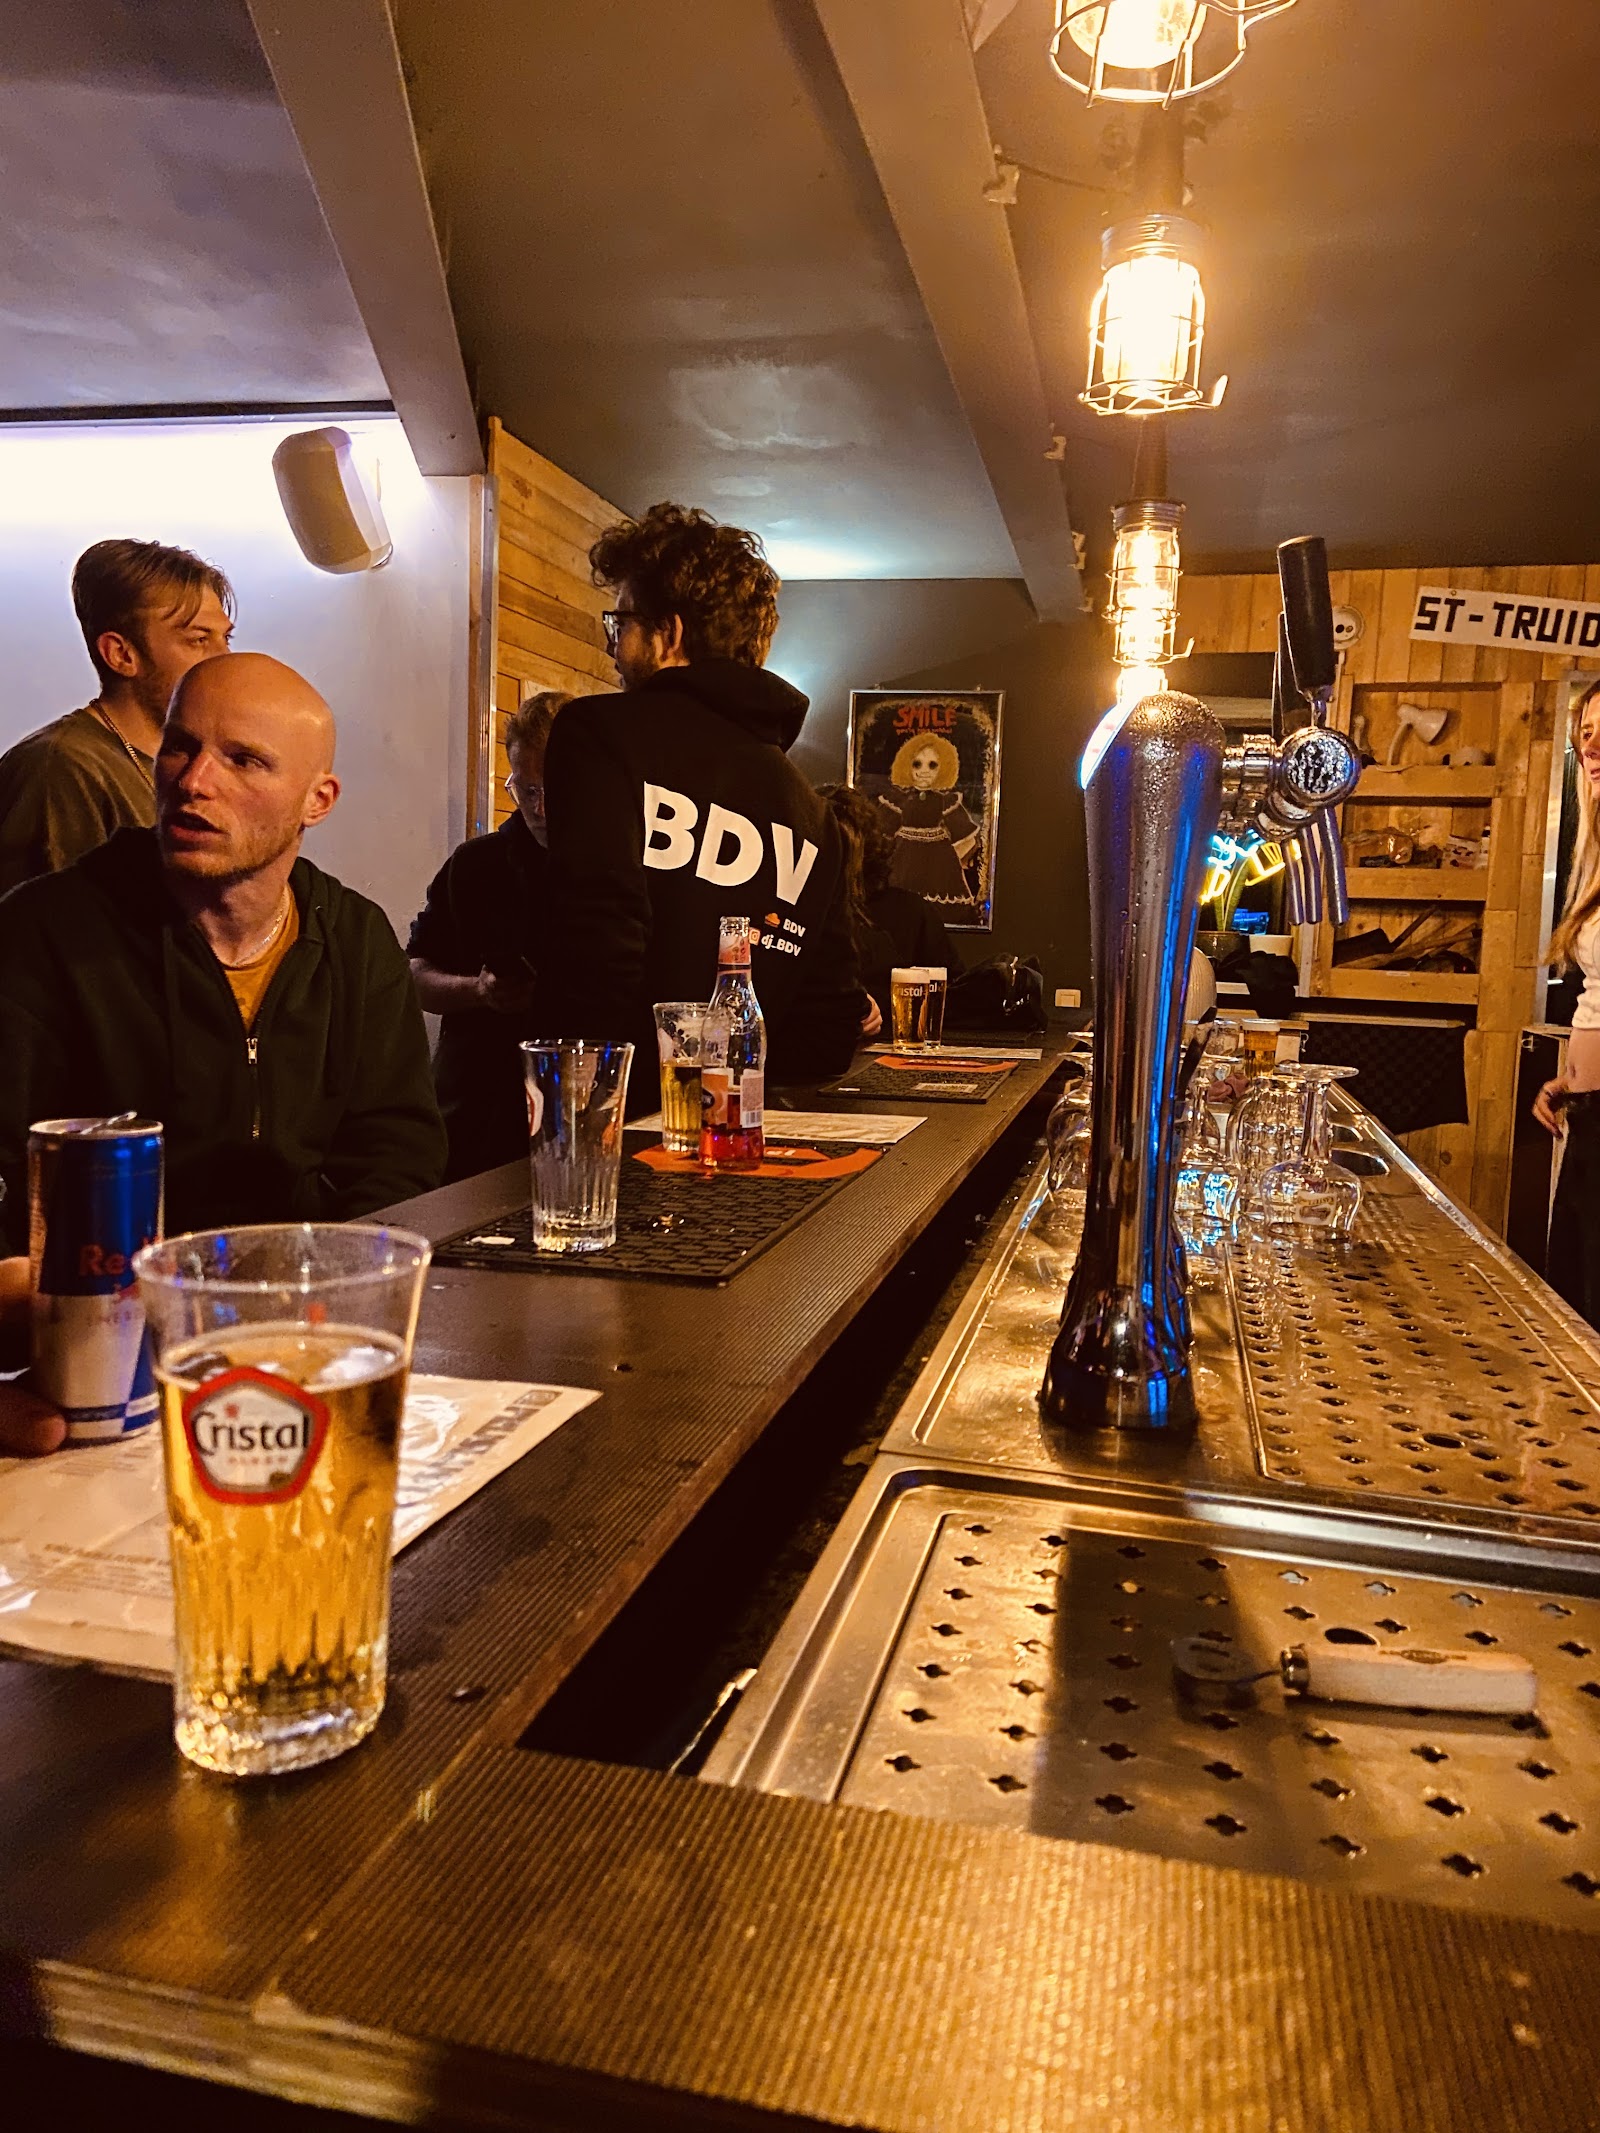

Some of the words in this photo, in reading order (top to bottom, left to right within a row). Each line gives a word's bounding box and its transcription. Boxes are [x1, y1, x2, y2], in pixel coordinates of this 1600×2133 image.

[643, 781, 818, 905] BDV
[761, 934, 801, 957] dj_BDV
[783, 919, 806, 938] BDV
[191, 1404, 310, 1456] Cristal
